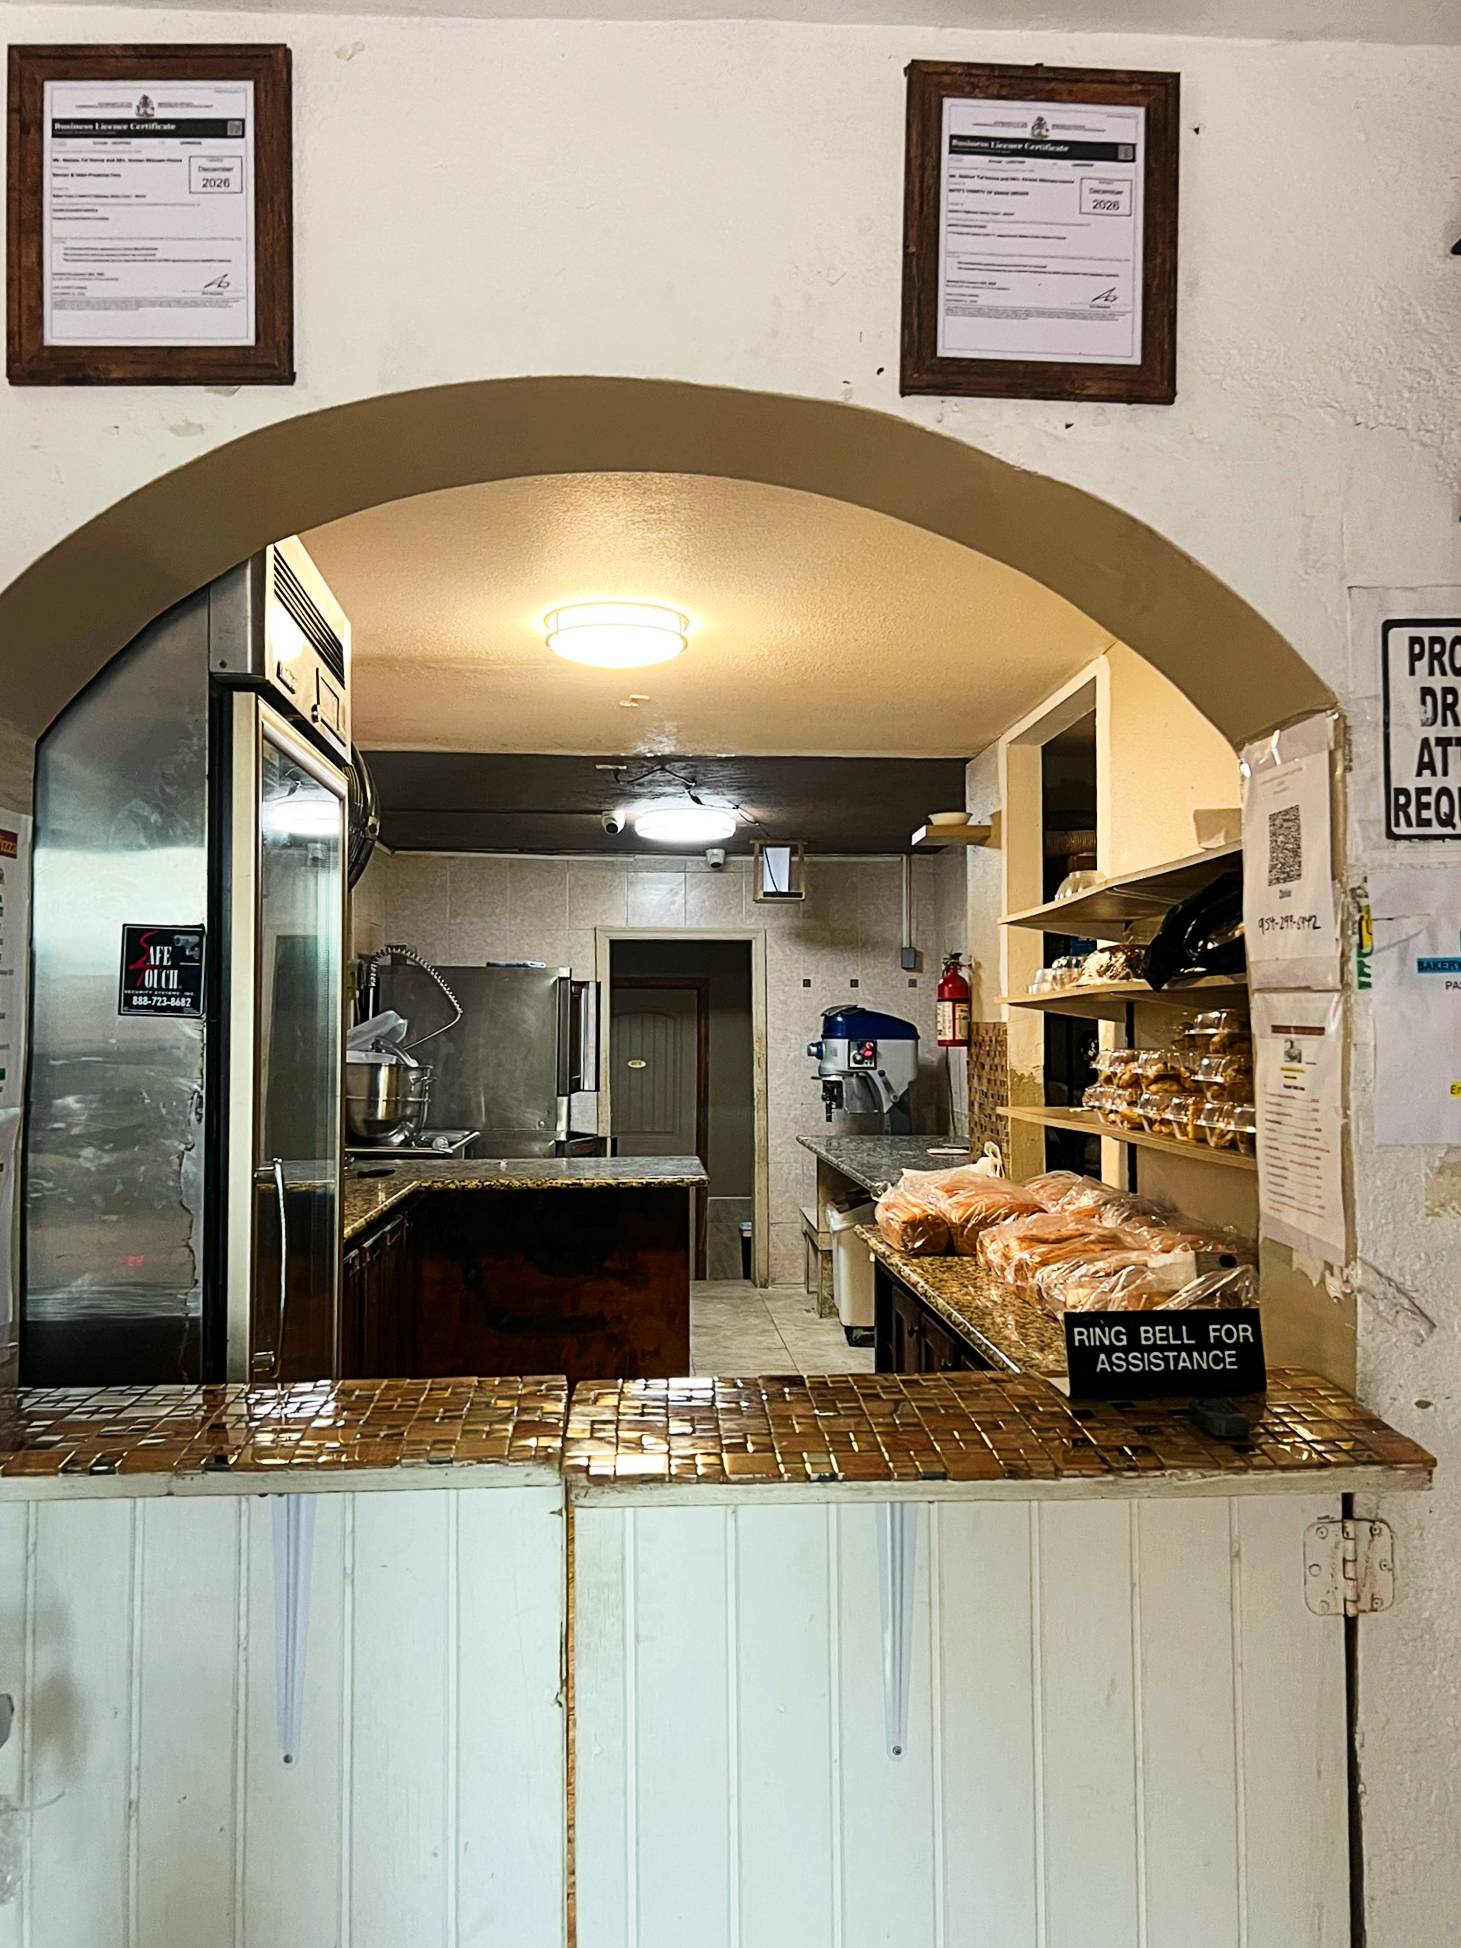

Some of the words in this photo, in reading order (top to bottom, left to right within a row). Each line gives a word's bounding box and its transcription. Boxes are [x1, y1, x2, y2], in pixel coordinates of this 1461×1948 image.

[54, 122, 94, 130] Business
[130, 122, 176, 130] Certificate
[1025, 142, 1069, 152] Certificate
[202, 177, 231, 188] 2026
[1393, 786, 1461, 831] REQ
[1073, 1326, 1128, 1347] RING
[1139, 1325, 1196, 1345] BELL
[1208, 1324, 1255, 1344] FOR
[1096, 1350, 1239, 1373] ASSISTANCE
